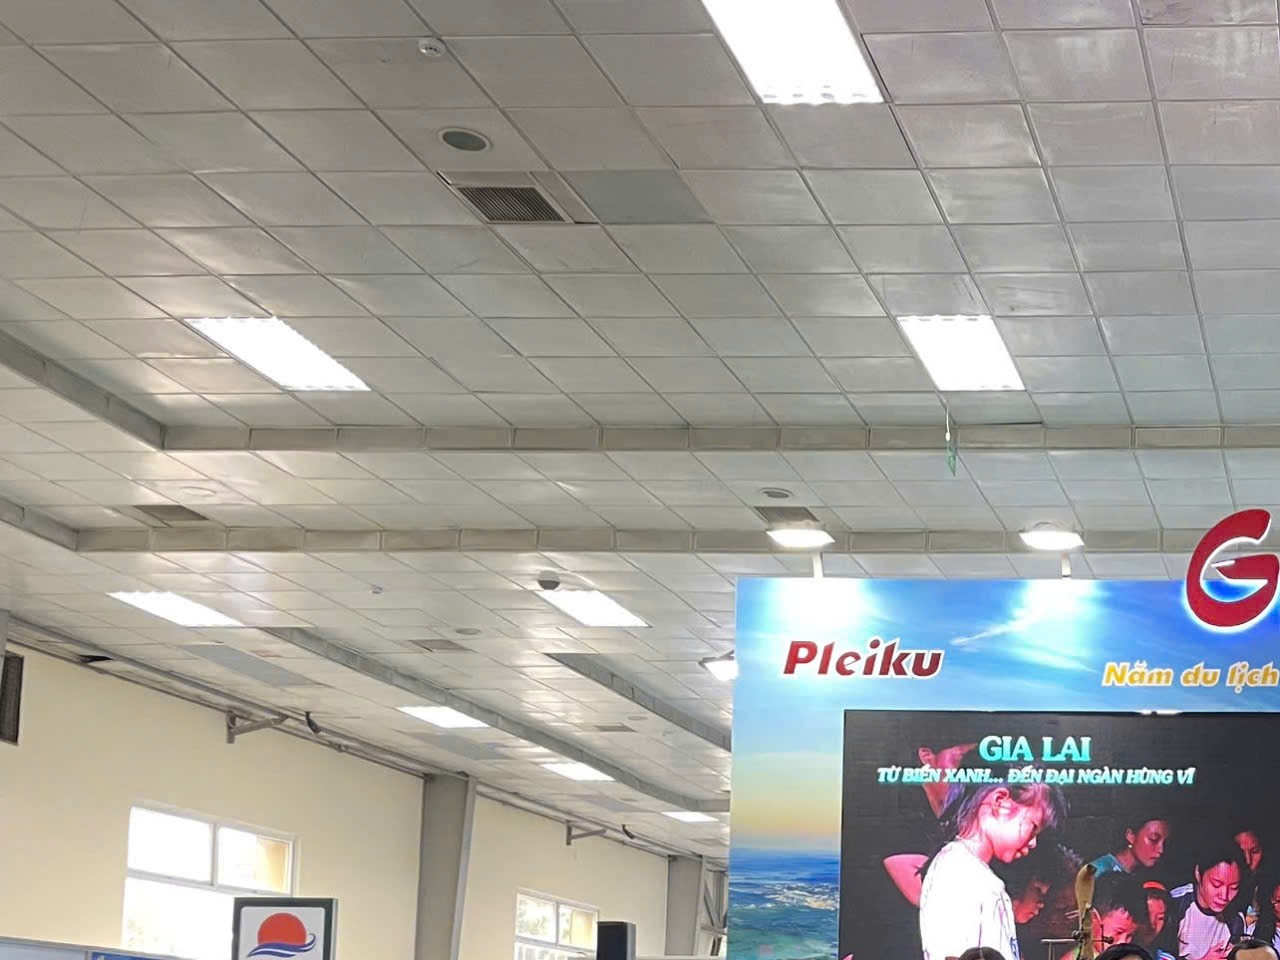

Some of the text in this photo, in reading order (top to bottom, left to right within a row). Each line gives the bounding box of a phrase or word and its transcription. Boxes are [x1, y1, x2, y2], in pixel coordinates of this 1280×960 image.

[781, 636, 945, 679] Pleiku
[1102, 660, 1174, 687] Năm
[1180, 662, 1221, 687] du
[1226, 661, 1280, 693] lịch
[979, 736, 1091, 761] GIA LAI
